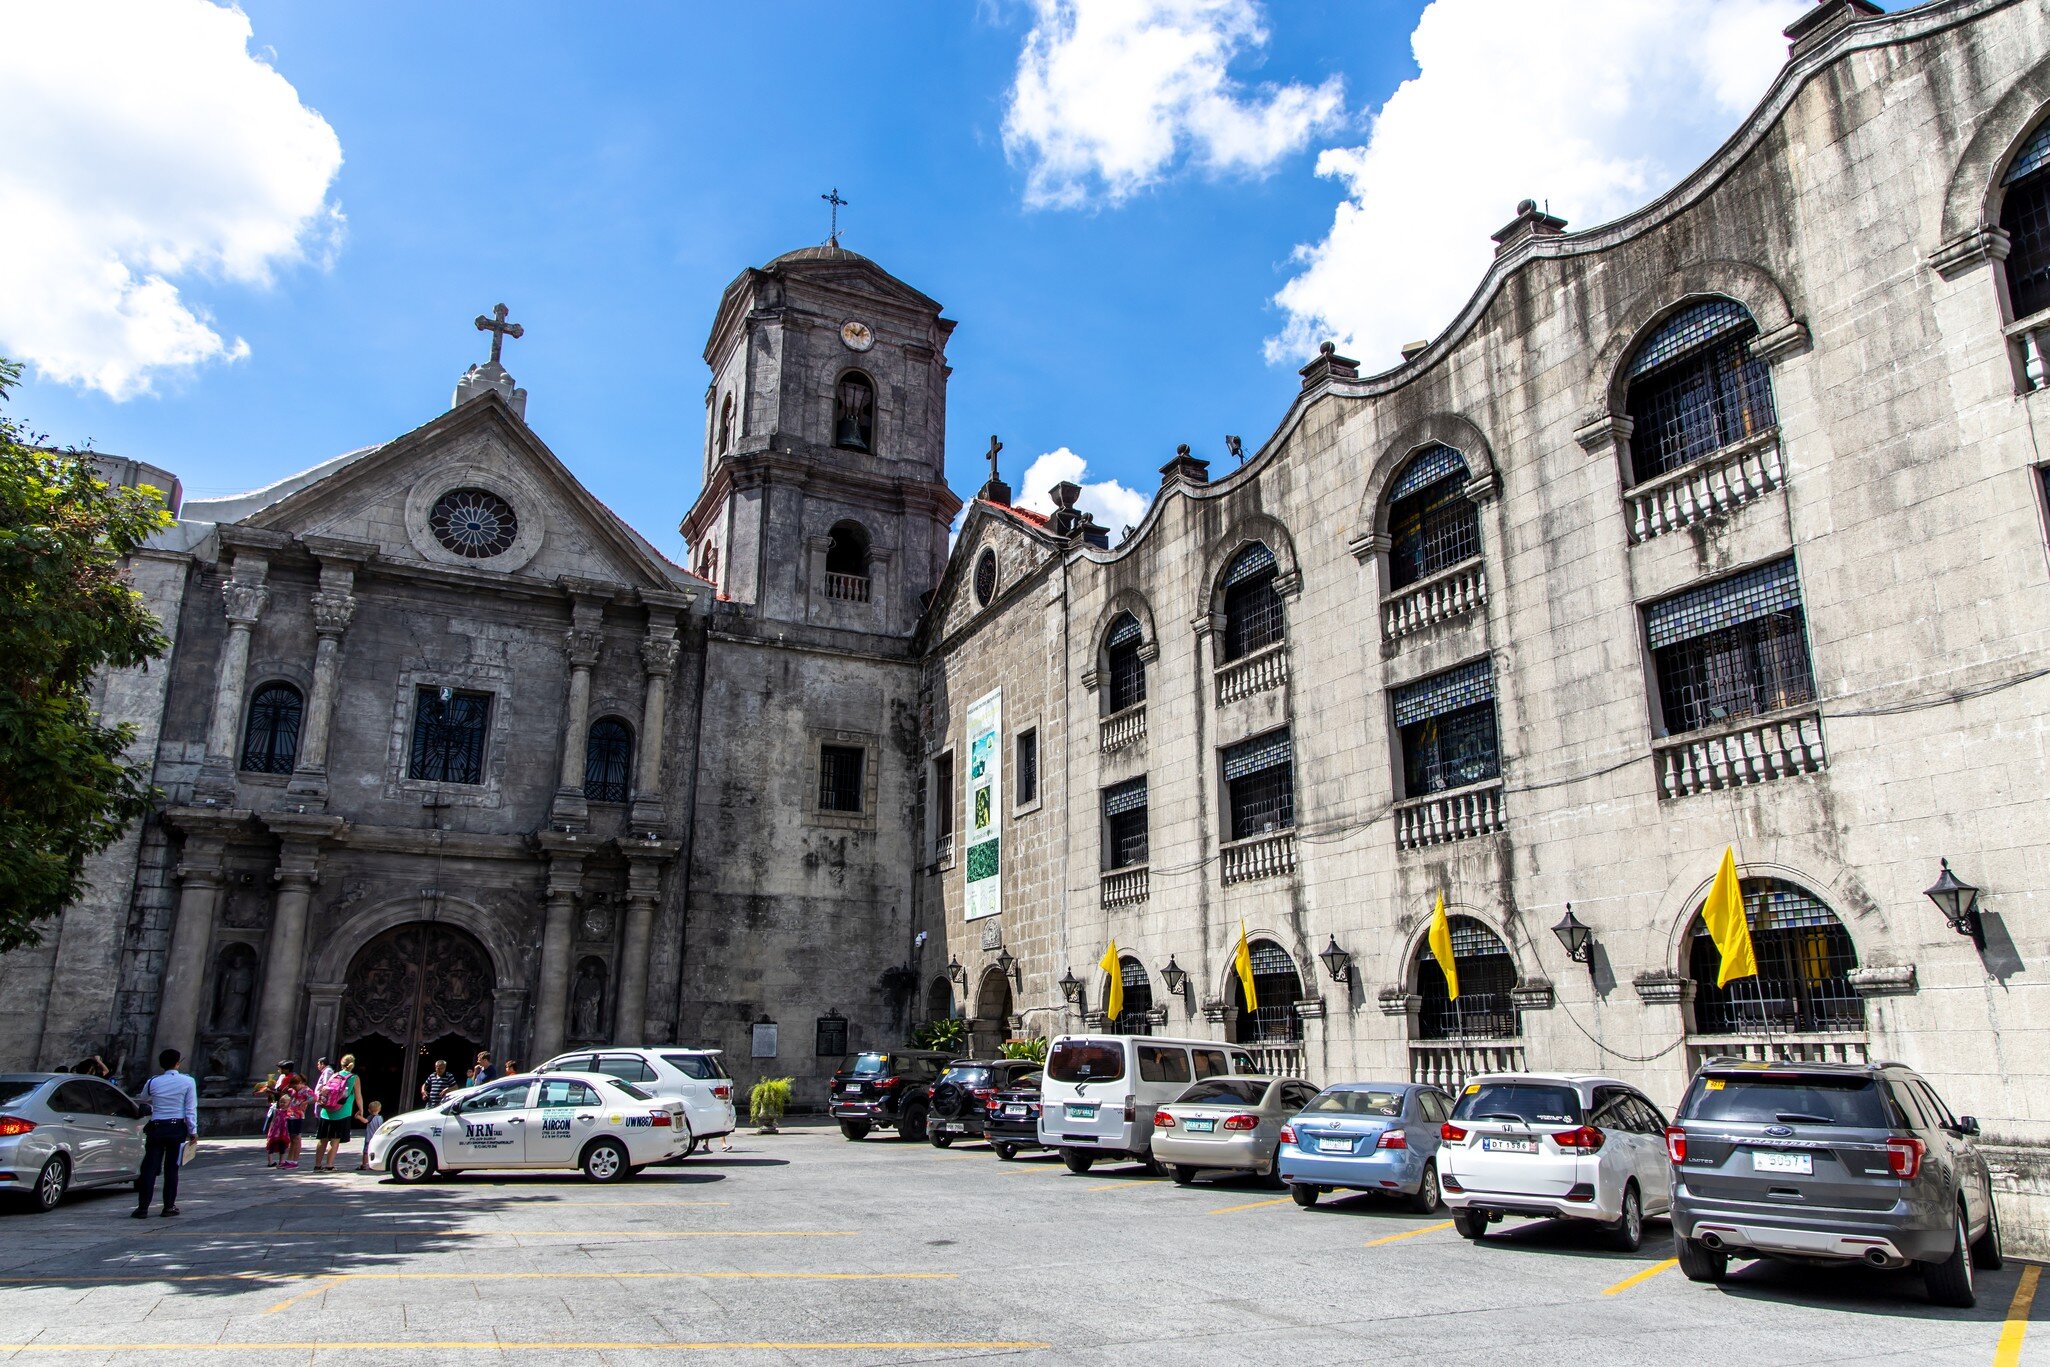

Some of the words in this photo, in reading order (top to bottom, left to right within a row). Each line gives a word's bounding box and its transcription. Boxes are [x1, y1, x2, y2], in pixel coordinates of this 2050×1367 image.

[466, 1123, 494, 1137] NRN
[542, 1119, 571, 1130] AIRCON
[1688, 1156, 1714, 1164] LIMITED
